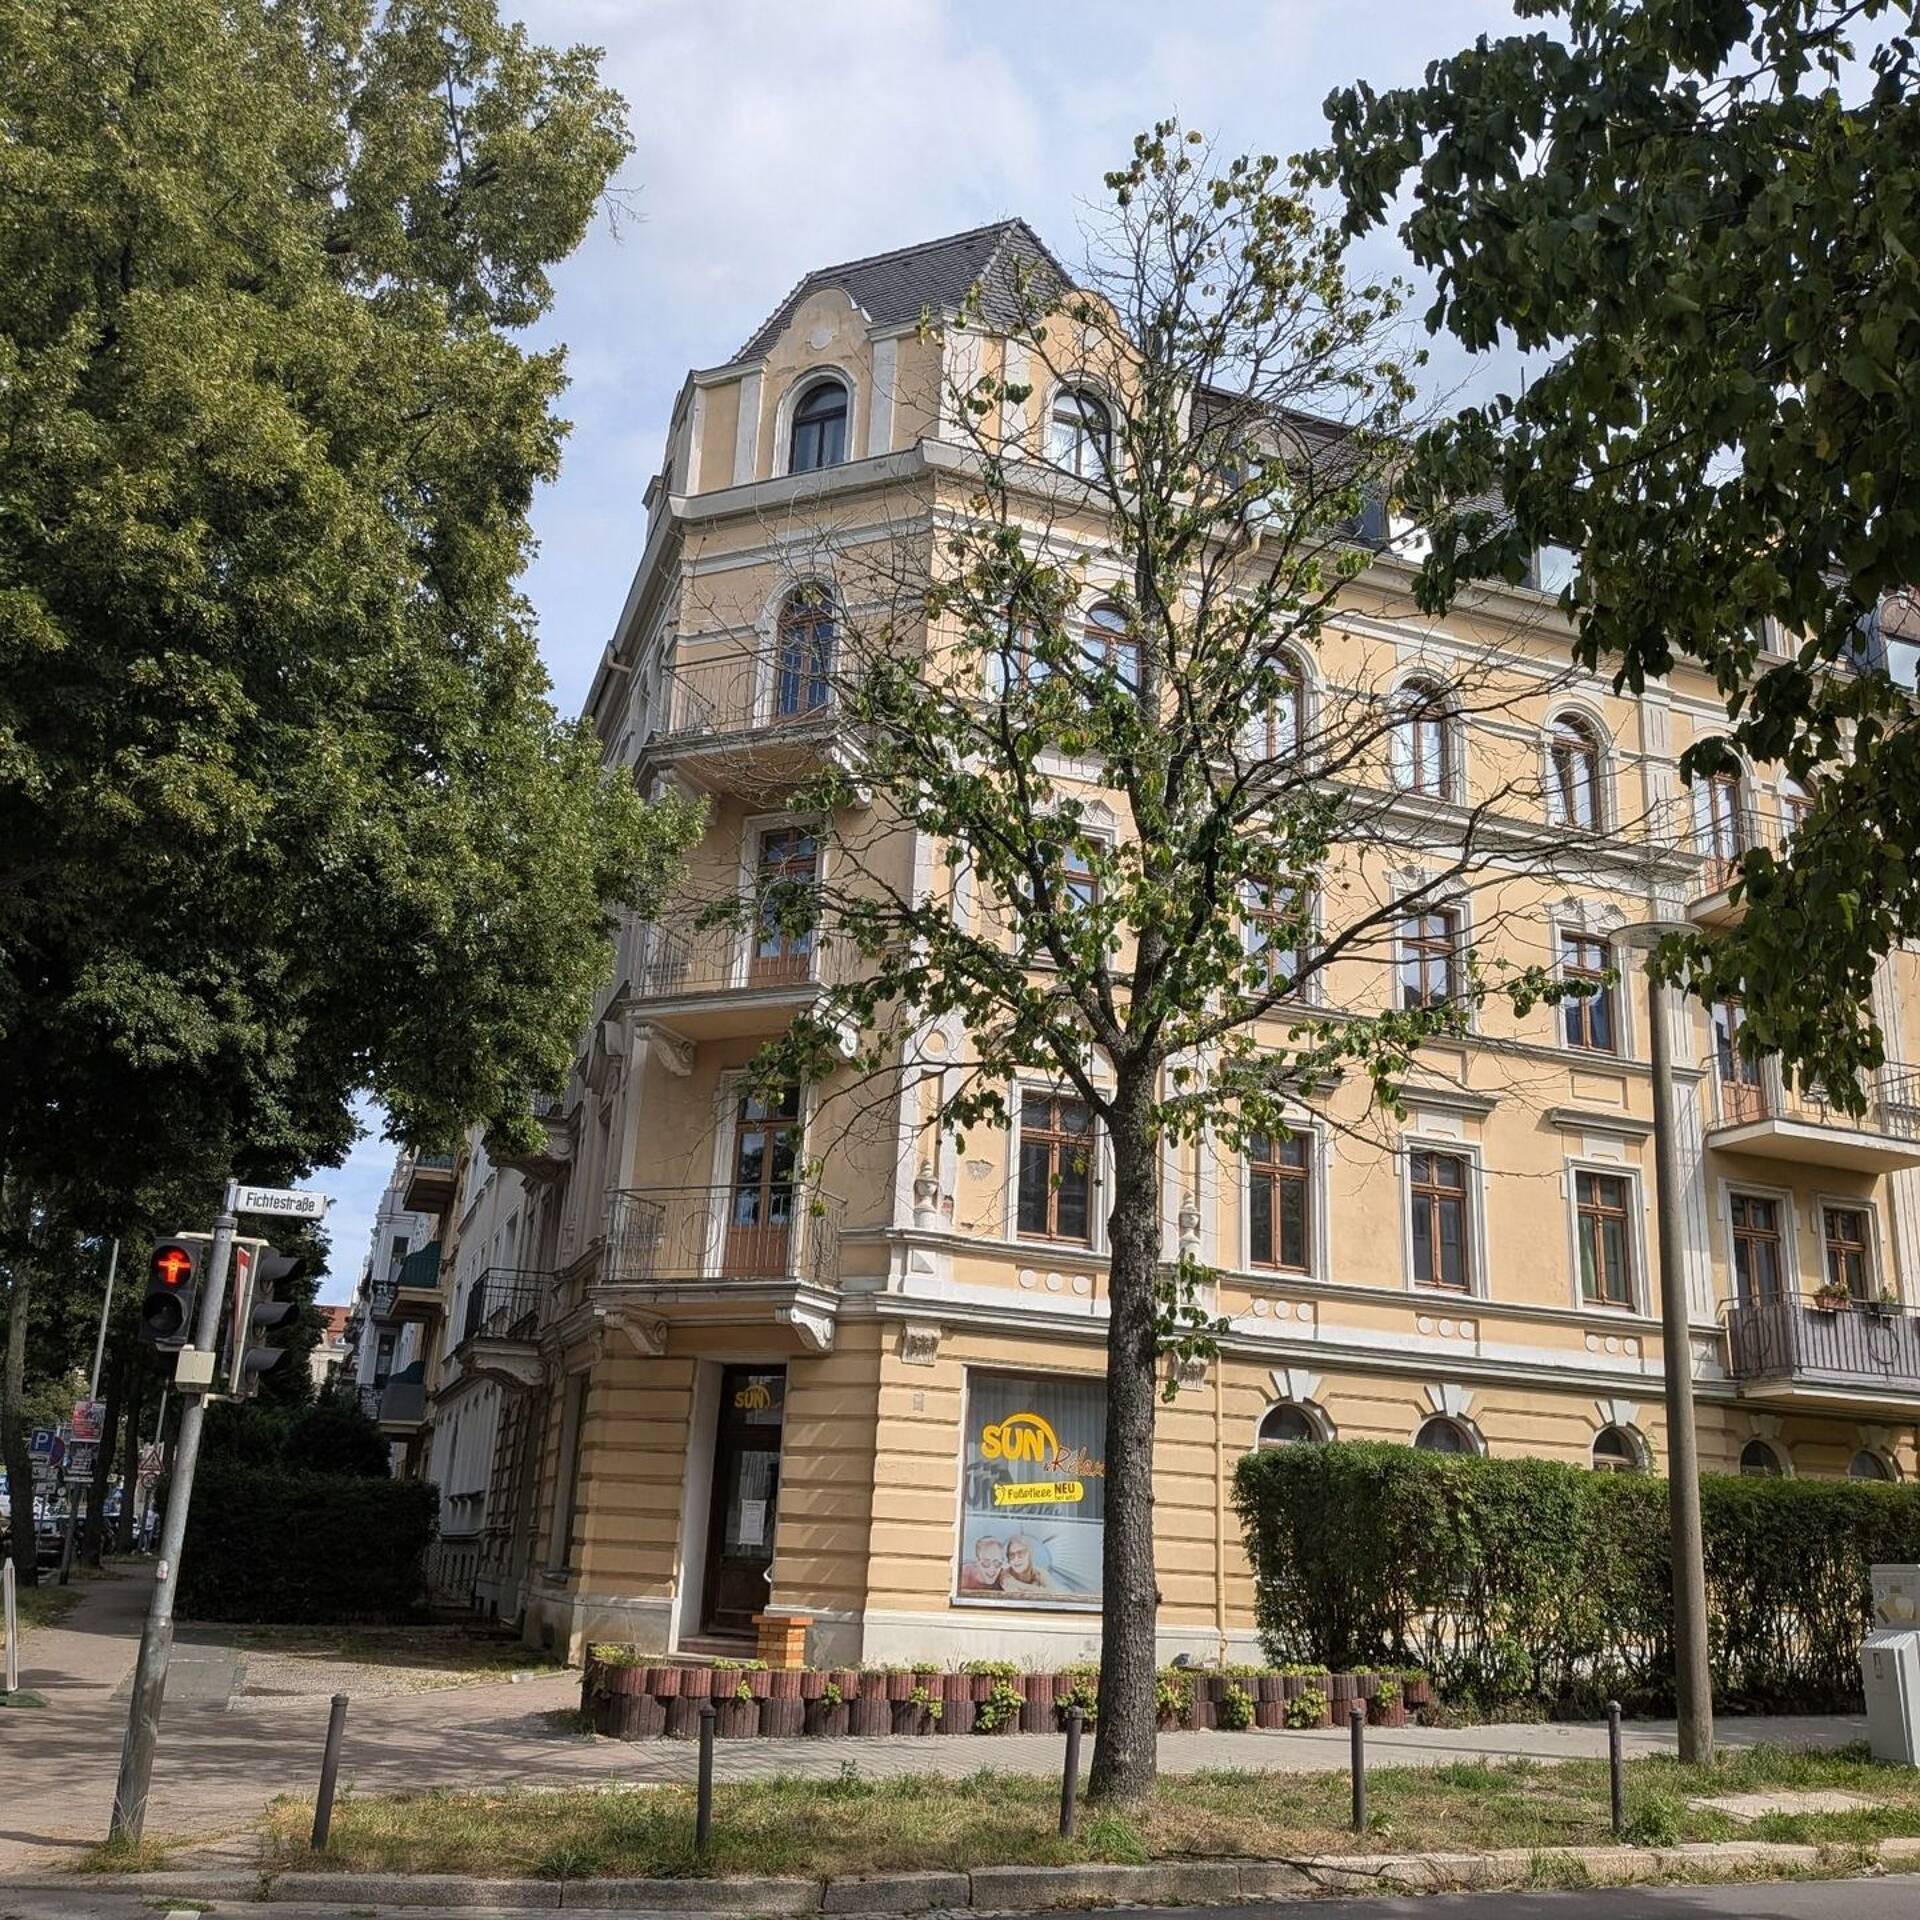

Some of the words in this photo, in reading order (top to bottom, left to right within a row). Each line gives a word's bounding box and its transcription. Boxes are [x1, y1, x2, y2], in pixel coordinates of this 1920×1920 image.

[246, 1191, 316, 1213] Fichtestraße
[734, 1391, 764, 1408] SUN
[35, 1432, 49, 1450] P
[981, 1425, 1045, 1462] SUN
[1054, 1483, 1076, 1495] NEU
